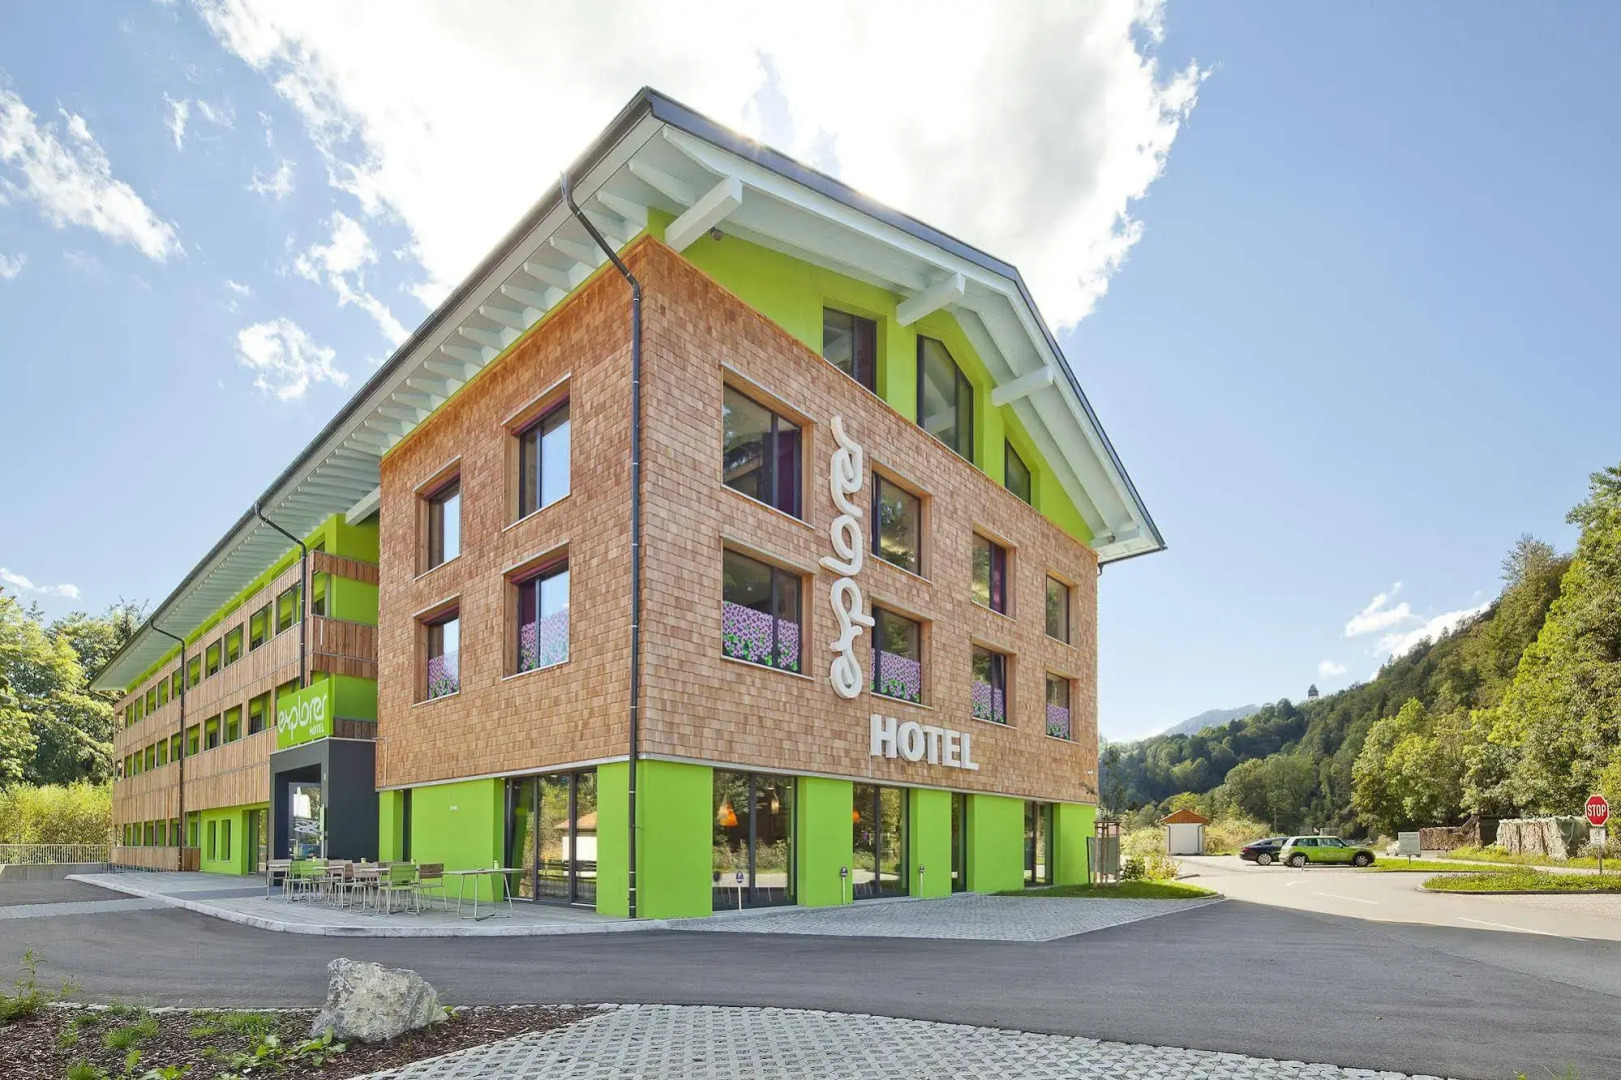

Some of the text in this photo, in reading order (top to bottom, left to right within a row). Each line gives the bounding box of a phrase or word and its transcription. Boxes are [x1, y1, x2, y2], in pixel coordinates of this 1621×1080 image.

[818, 414, 875, 699] explorer
[279, 694, 327, 740] explorer
[309, 723, 325, 735] HOTEL
[870, 714, 979, 770] HOTEL
[1587, 804, 1606, 817] STOP
